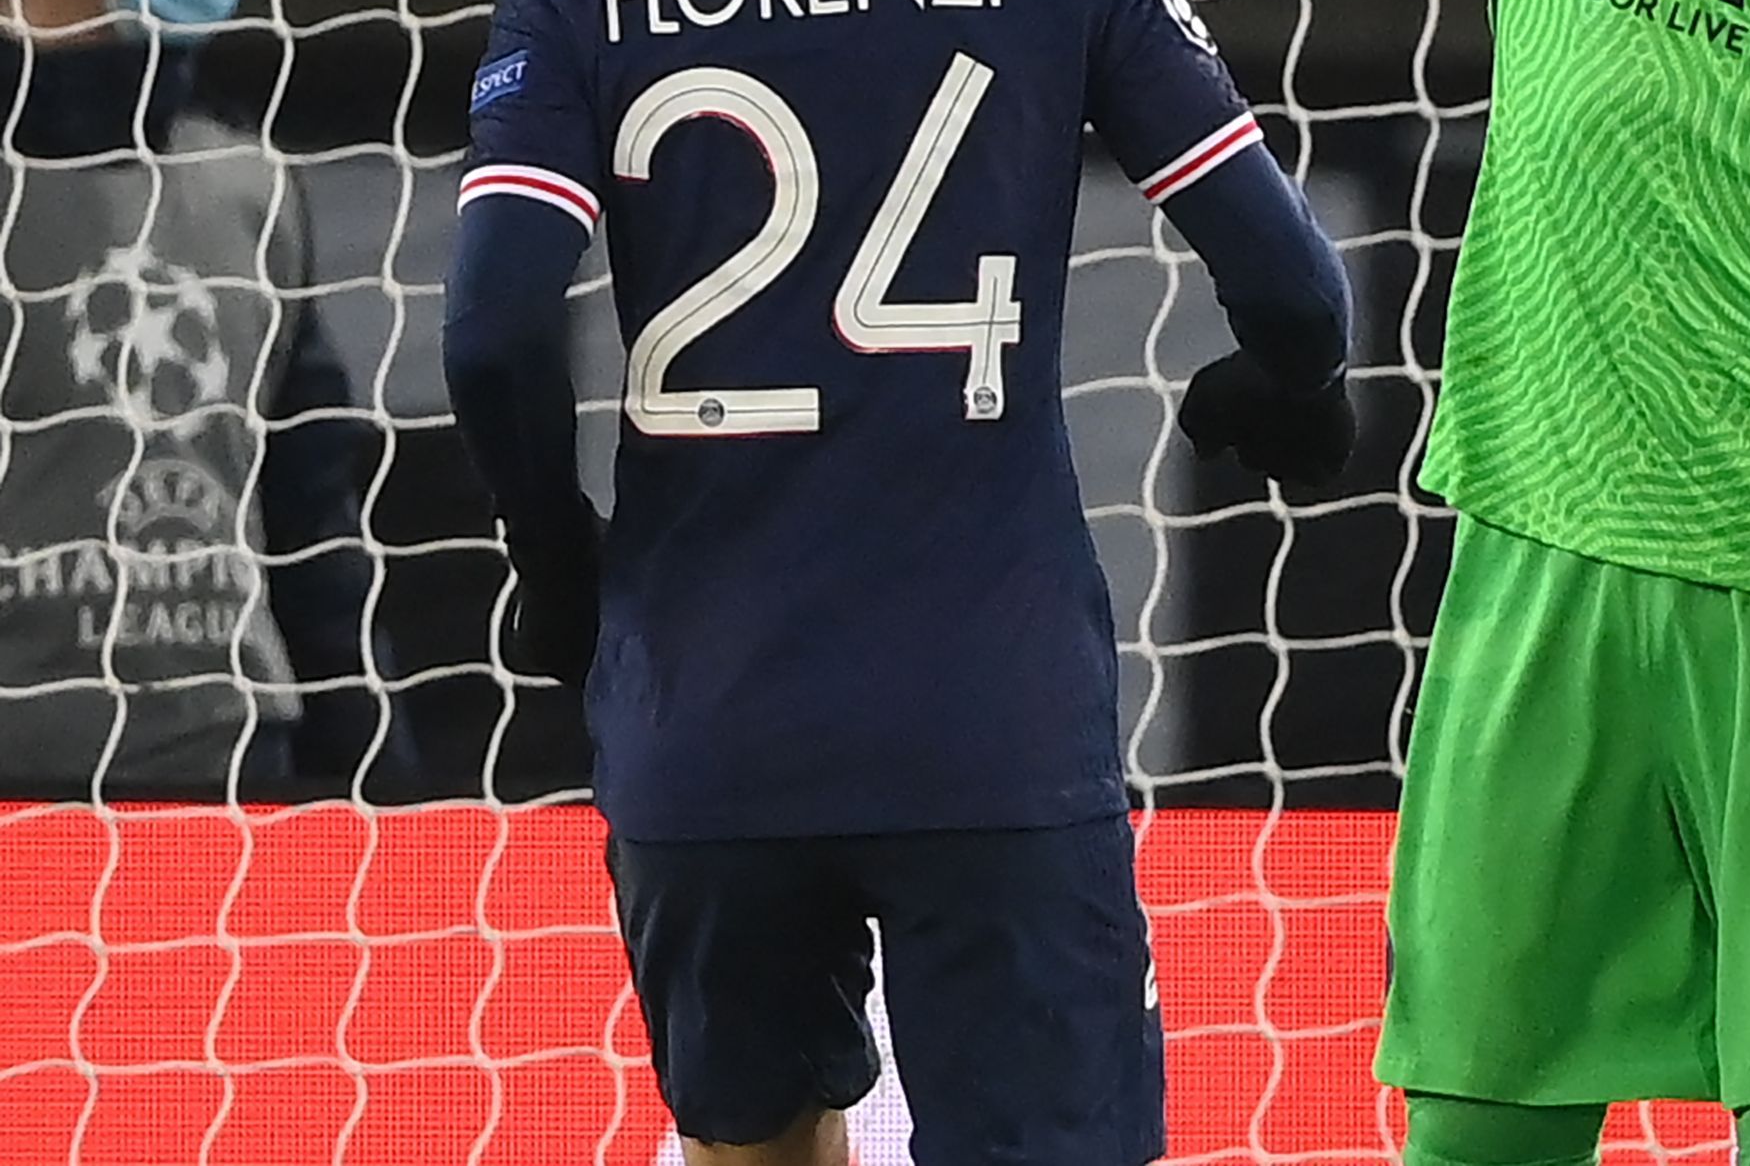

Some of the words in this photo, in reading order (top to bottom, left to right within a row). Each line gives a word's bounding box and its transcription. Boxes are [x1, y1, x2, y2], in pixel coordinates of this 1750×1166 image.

[1666, 0, 1749, 54] LIVE
[612, 51, 1021, 437] 24
[78, 601, 240, 648] LEAGU
